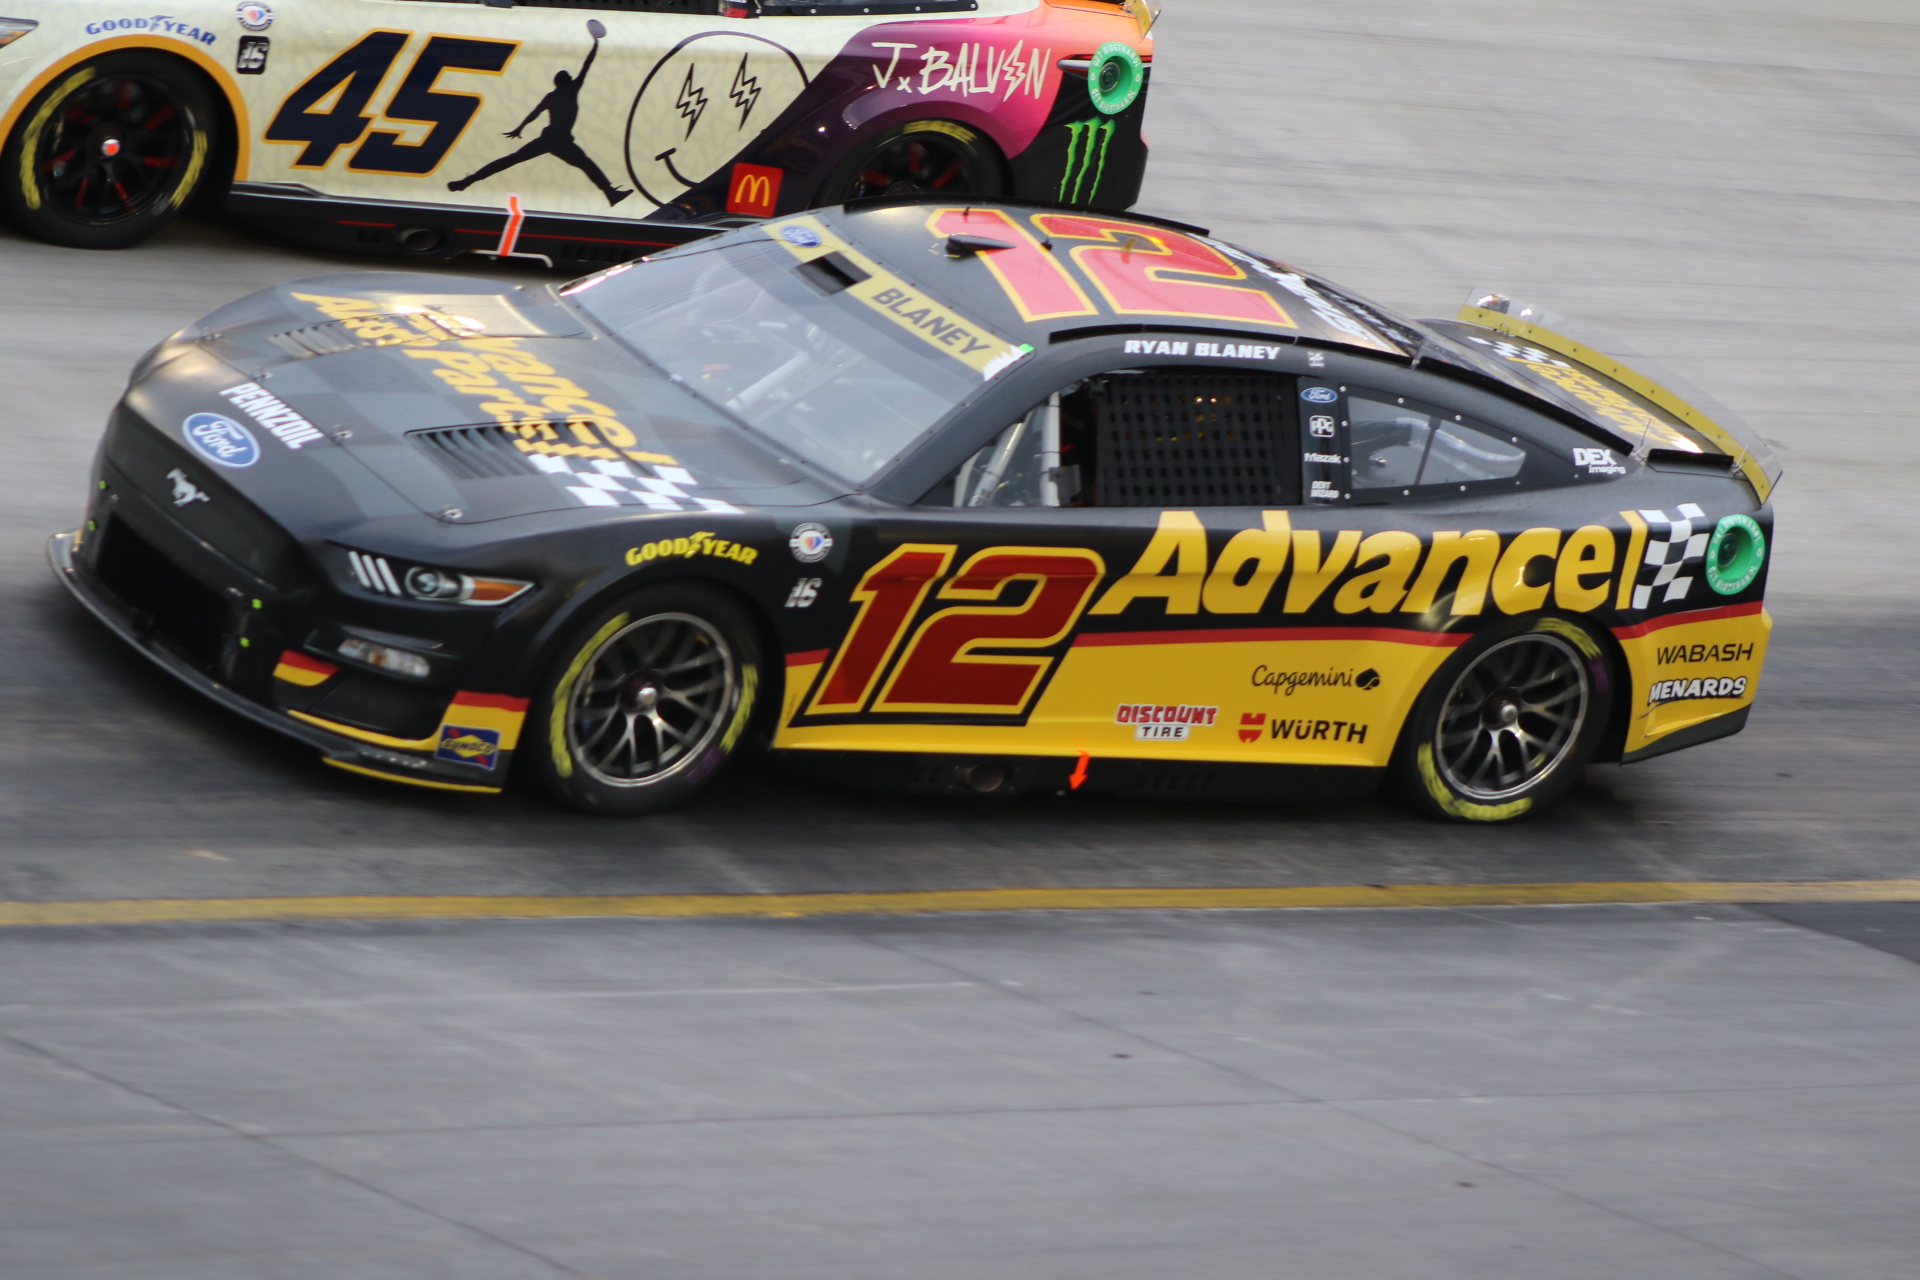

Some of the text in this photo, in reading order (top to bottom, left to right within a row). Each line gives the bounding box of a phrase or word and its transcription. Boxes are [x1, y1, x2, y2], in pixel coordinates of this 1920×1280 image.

[85, 15, 216, 46] GOODYEAR
[263, 27, 523, 177] 45
[924, 207, 1299, 329] 12
[871, 287, 993, 355] BLANEY
[1124, 340, 1281, 360] RYAN BLANEY
[218, 382, 325, 450] PENNZOIL
[1312, 418, 1333, 435] PPG
[192, 420, 249, 458] Ford
[1304, 452, 1341, 464] Mazak
[1572, 448, 1617, 466] DEX
[1310, 489, 1339, 500] WIZARD
[625, 531, 758, 566] GOODYEAR
[804, 543, 1106, 716] 12
[1657, 643, 1754, 665] WABASH
[1252, 665, 1354, 696] Capgemini
[1647, 676, 1747, 706] MENARDS
[1115, 703, 1218, 726] DISCOUNT
[441, 738, 498, 755] SUNOCO
[1142, 726, 1183, 738] TIRE
